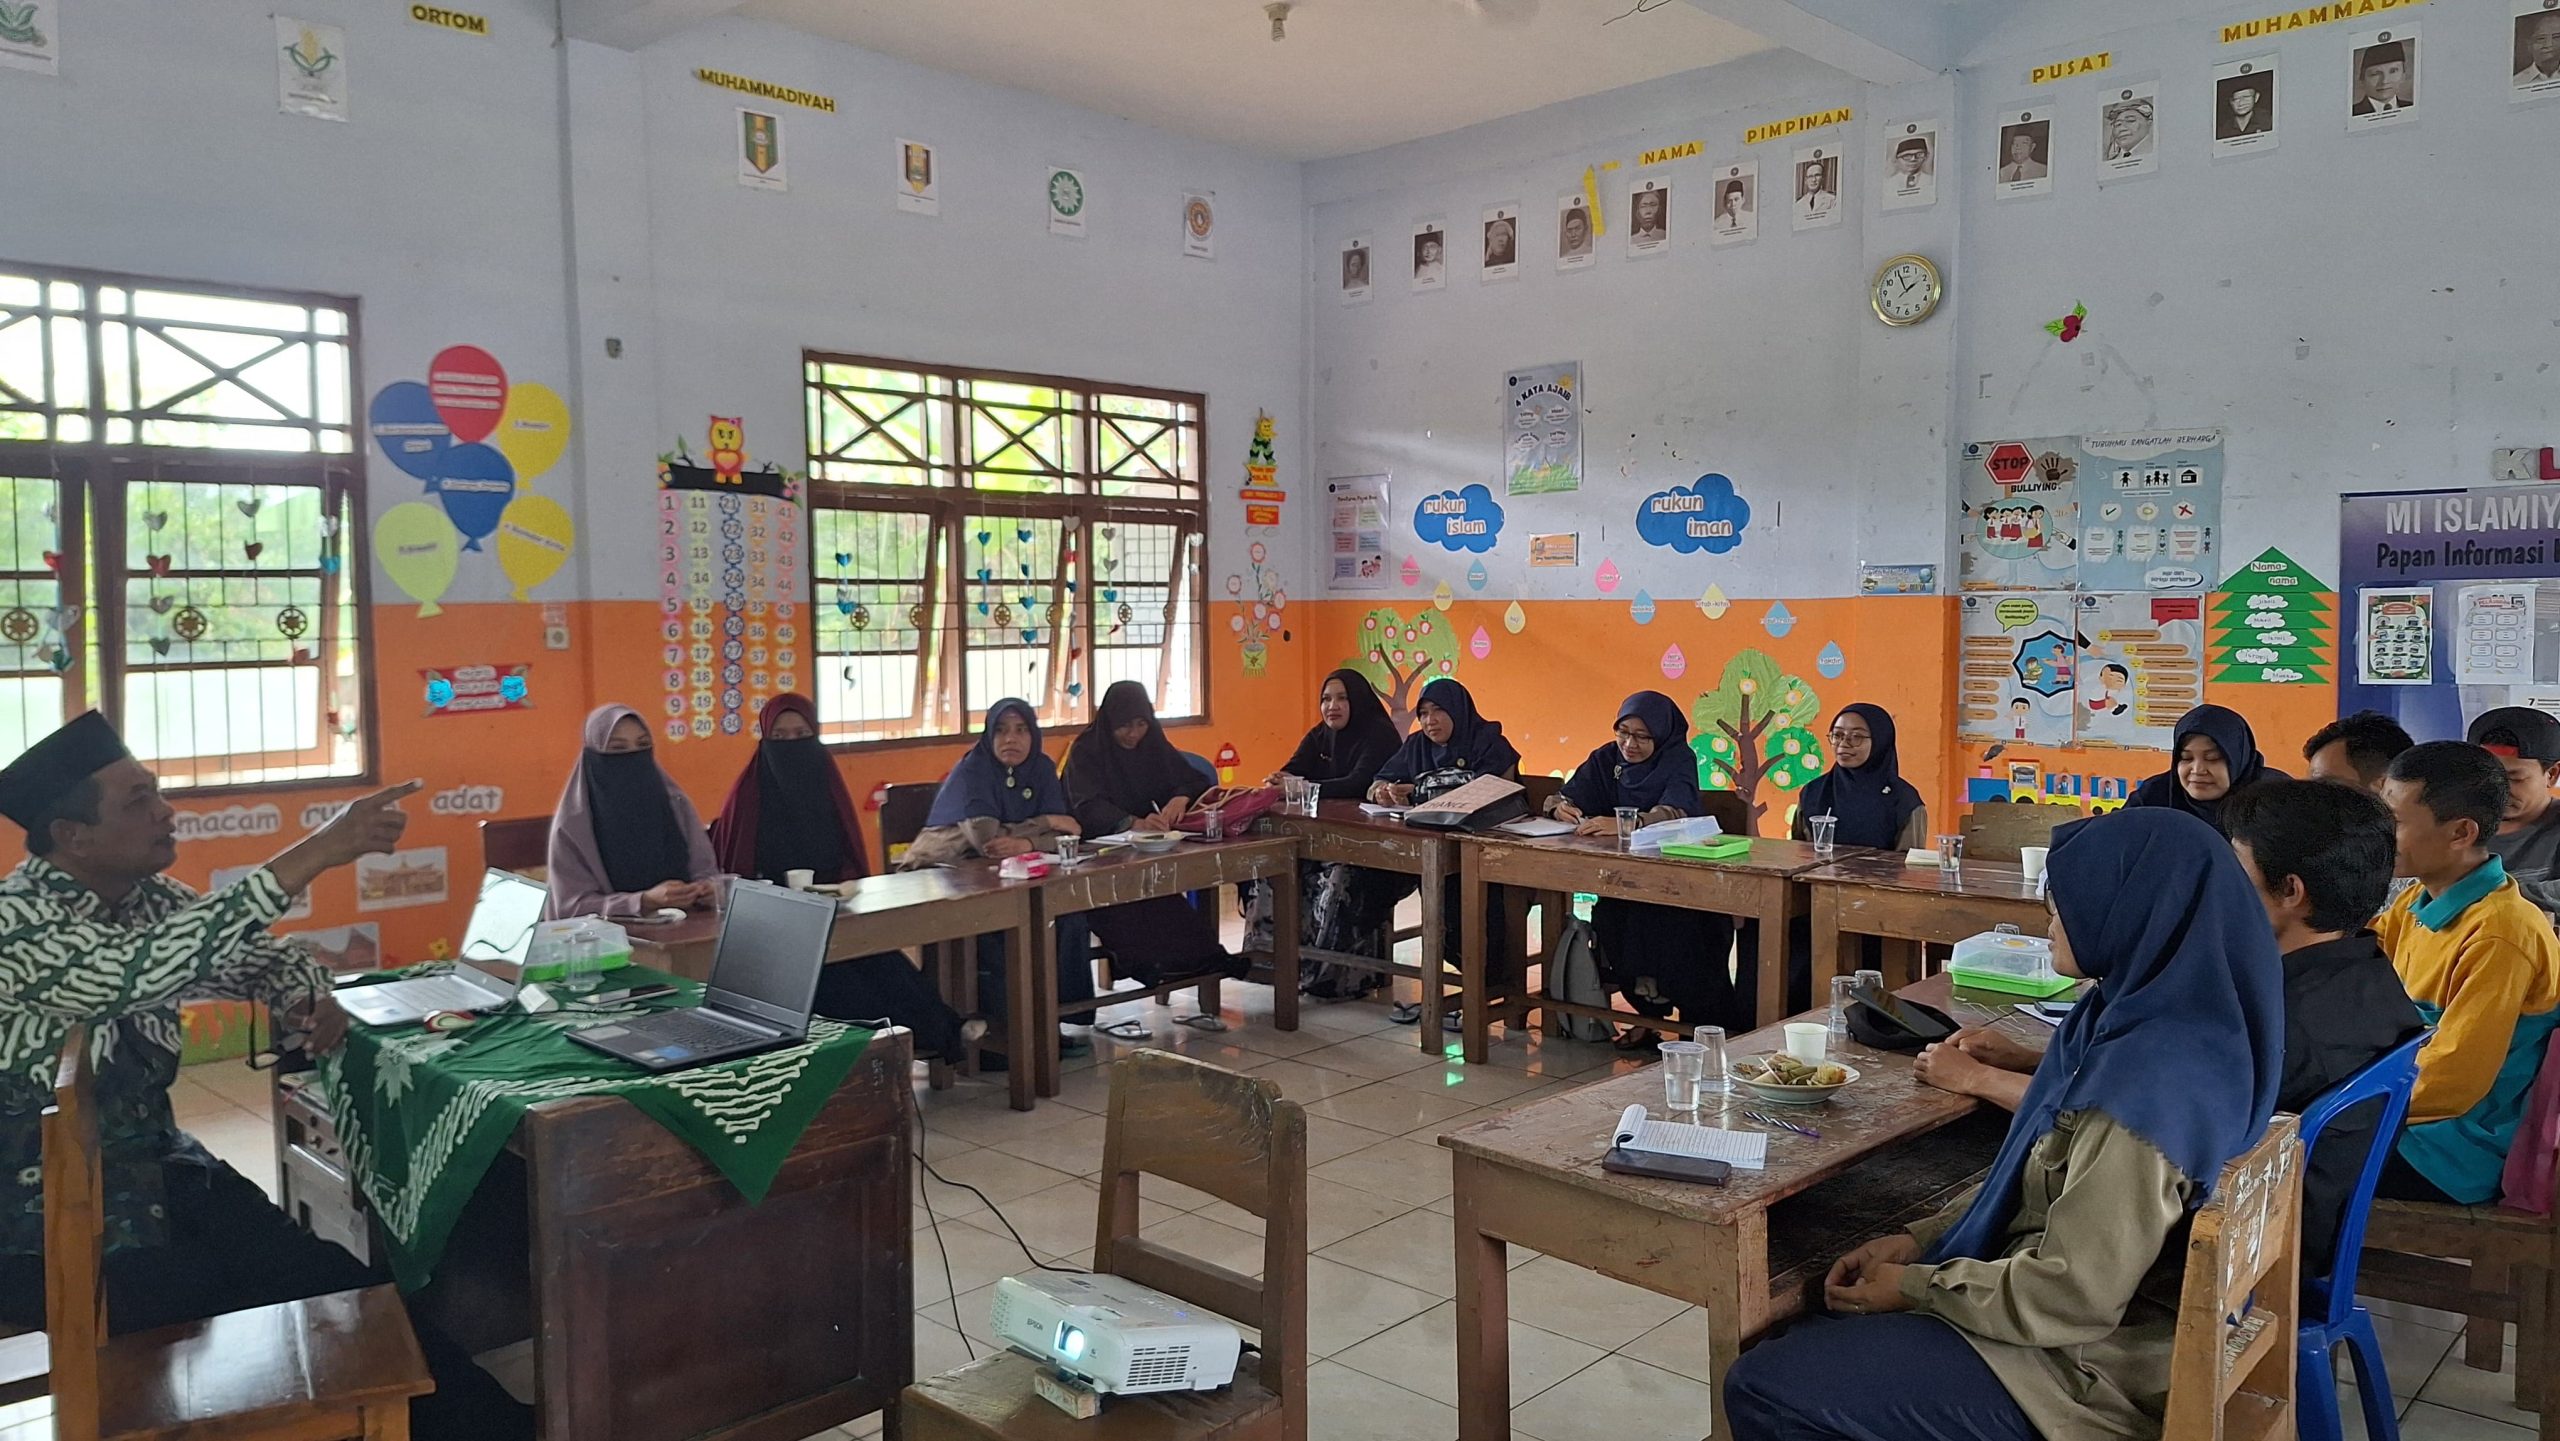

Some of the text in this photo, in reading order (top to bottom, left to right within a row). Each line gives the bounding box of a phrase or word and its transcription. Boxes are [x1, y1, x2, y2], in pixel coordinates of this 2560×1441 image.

[412, 5, 485, 33] ORTOM
[2032, 53, 2110, 83] PUSAT
[700, 69, 835, 112] MUHAMMADIYAH
[1747, 109, 1850, 143] PIMPINAN
[1644, 143, 1697, 165] NAMA
[1521, 384, 1544, 400] KATA
[1547, 384, 1571, 400] AJAIB
[1993, 457, 2029, 470] STOP
[666, 496, 674, 510] 1
[692, 497, 706, 508] 11
[724, 499, 736, 510] 21
[752, 503, 765, 513] 31
[1425, 498, 1466, 513] rukun
[1653, 494, 1703, 512] rukun
[779, 507, 791, 517] 41
[2386, 494, 2560, 534] MI ISLAMIY
[665, 521, 674, 535] 2
[692, 522, 707, 533] 12
[726, 524, 738, 535] 22
[1447, 517, 1486, 534] islam
[1688, 519, 1731, 536] iman
[752, 528, 765, 538] 32
[780, 532, 792, 542] 42
[666, 547, 675, 561] 3
[693, 547, 708, 559] 13
[727, 549, 740, 559] 23
[752, 552, 765, 562] 33
[2377, 542, 2435, 575] Papan
[2445, 539, 2544, 566] Informasi
[779, 556, 792, 566] 43
[2252, 563, 2286, 571] Nama-
[666, 572, 675, 586] 4
[694, 573, 709, 584] 14
[727, 573, 740, 583] 24
[752, 577, 765, 587] 34
[778, 581, 791, 591] 44
[667, 598, 677, 612] 5
[695, 599, 709, 610] 15
[729, 597, 741, 607] 25
[752, 602, 765, 612] 35
[778, 605, 791, 615] 45
[668, 623, 678, 638] 6
[695, 623, 709, 634] 16
[727, 621, 741, 631] 26
[751, 626, 764, 636] 36
[778, 628, 792, 638] 46
[669, 649, 678, 663] 7
[695, 648, 709, 659] 17
[727, 646, 740, 656] 27
[753, 652, 765, 661] 37
[779, 653, 792, 662] 47
[727, 669, 740, 679] 28
[670, 673, 679, 687] 8
[753, 675, 767, 685] 38
[779, 676, 792, 686] 48
[696, 695, 711, 707] 19
[726, 694, 739, 704] 29
[2527, 698, 2536, 706] 7
[670, 698, 680, 713] 9
[696, 720, 711, 731] 20
[726, 719, 740, 728] 30
[670, 725, 685, 736] 10
[433, 787, 500, 811] adat
[176, 812, 279, 834] macam
[1026, 1317, 1044, 1332] EPSON
